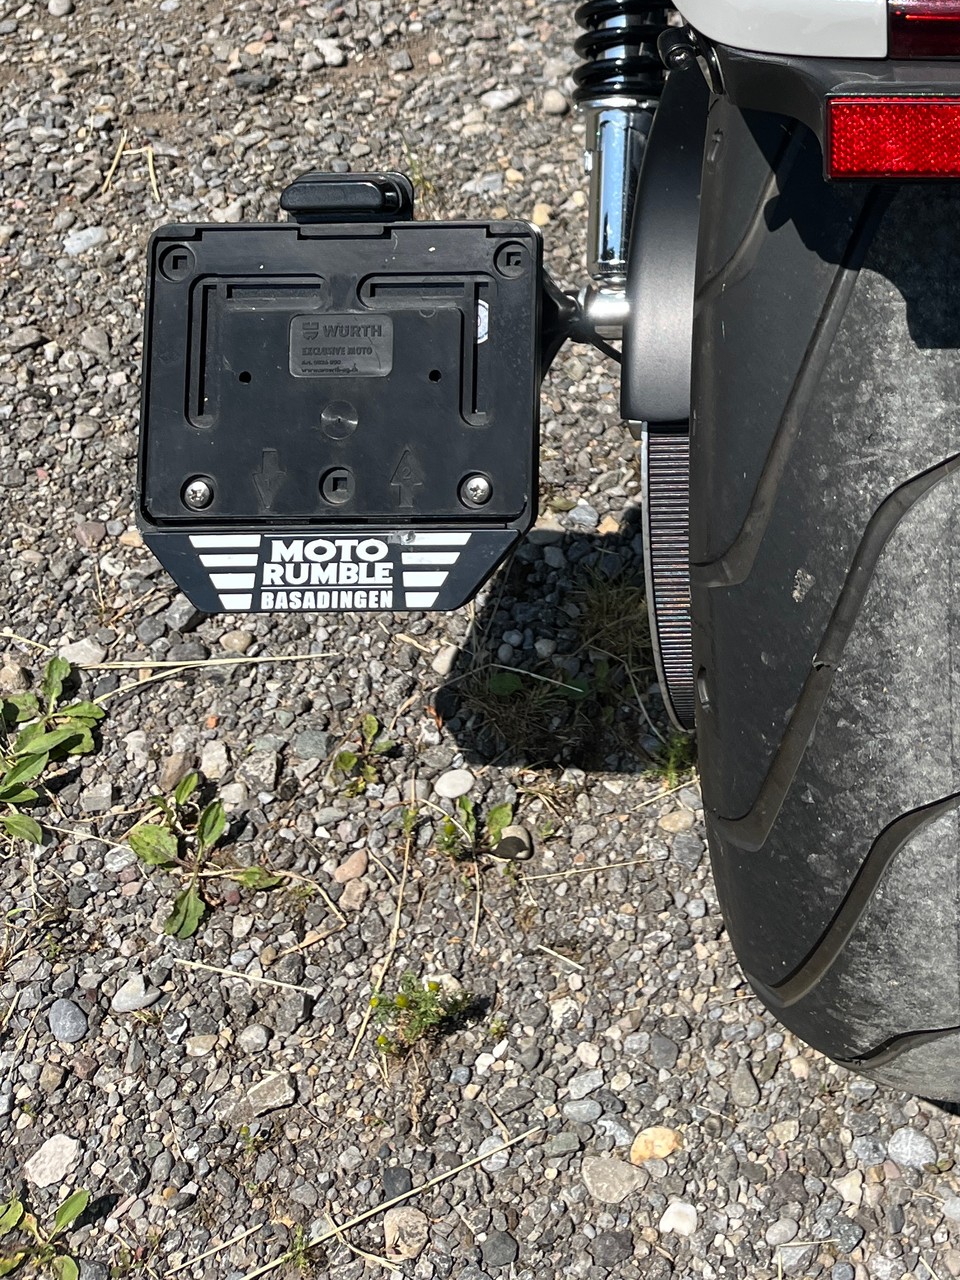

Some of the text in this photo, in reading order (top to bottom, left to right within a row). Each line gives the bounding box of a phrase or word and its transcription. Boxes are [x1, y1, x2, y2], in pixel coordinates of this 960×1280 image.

[322, 322, 382, 338] WÜRTH
[302, 347, 373, 356] EXCLUSIVE MOTO
[270, 538, 389, 562] MOTO
[262, 562, 394, 585] RUMBLE
[260, 590, 393, 610] BASADINGEN
